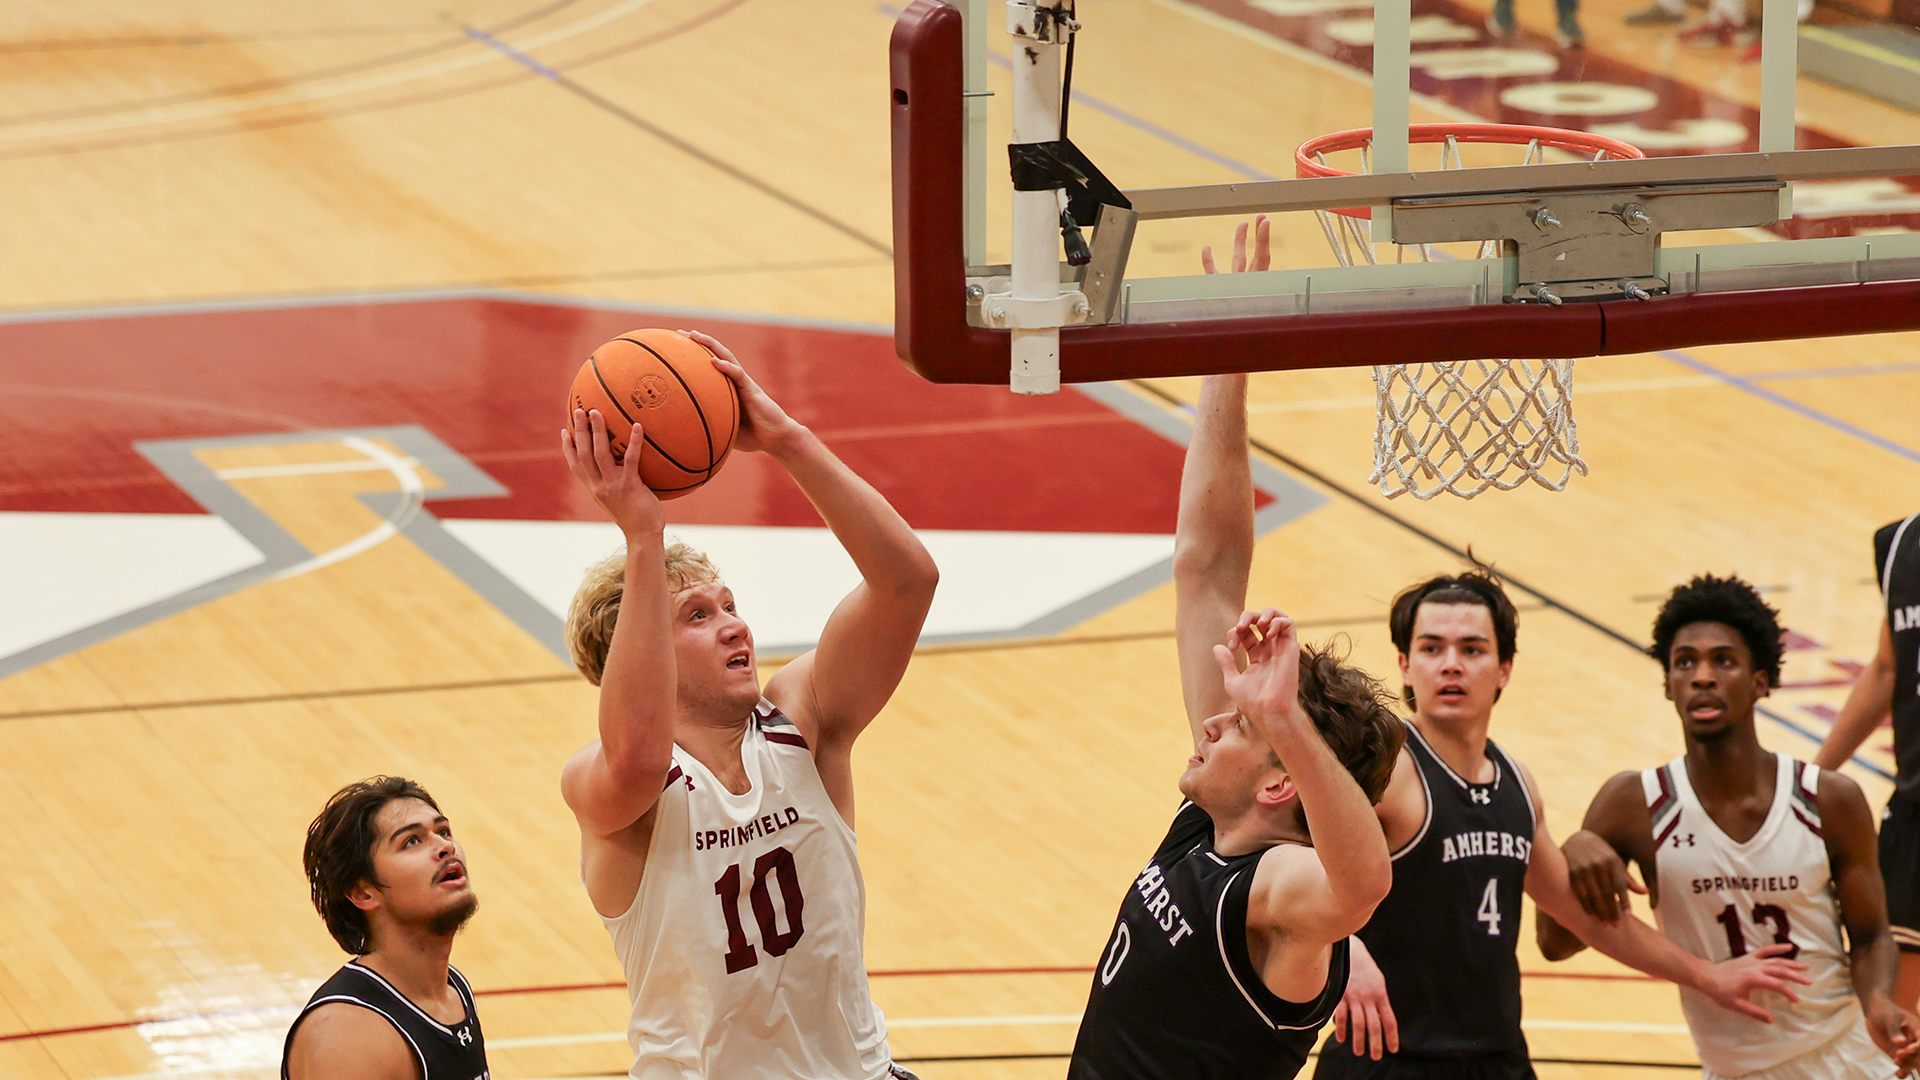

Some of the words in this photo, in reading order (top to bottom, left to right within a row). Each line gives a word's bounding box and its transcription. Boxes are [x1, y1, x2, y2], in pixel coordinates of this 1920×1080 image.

[695, 806, 800, 851] SPRINFIELD
[714, 846, 805, 974] 10
[1477, 878, 1502, 935] 4
[1692, 875, 1799, 894] SPRINGFIELD
[1102, 921, 1131, 986] 0
